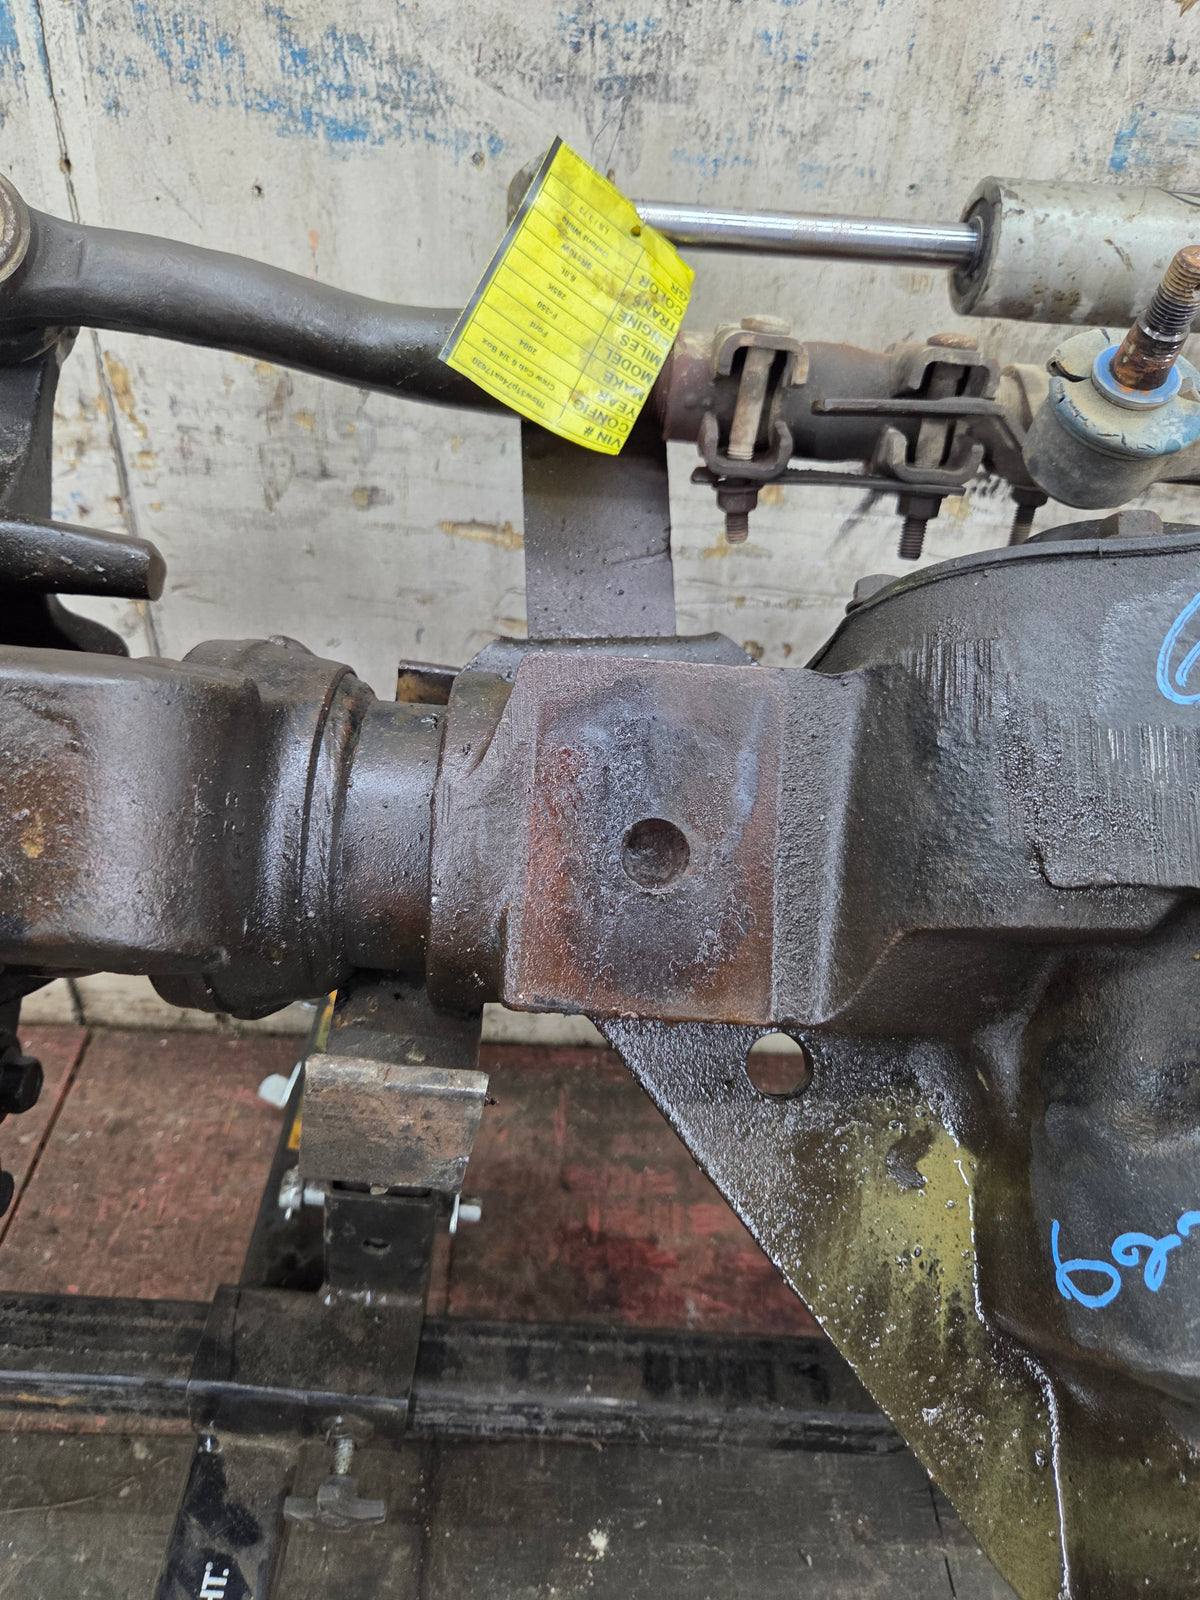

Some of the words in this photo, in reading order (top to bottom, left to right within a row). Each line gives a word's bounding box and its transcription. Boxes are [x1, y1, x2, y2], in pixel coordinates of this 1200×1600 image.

[637, 274, 683, 316] COLOR
[669, 282, 688, 302] GR
[536, 300, 558, 319] F-350
[631, 293, 676, 333] TRANS
[528, 320, 548, 337] Ford
[615, 309, 670, 349] ENGINE
[518, 338, 537, 355] 2004
[618, 333, 662, 366] MILES
[601, 346, 653, 383] MODEL
[601, 369, 645, 401] MAKE
[571, 398, 629, 434] CONFIG
[595, 389, 637, 418] YEAR
[582, 425, 594, 437] #
[596, 431, 622, 448] VIN
